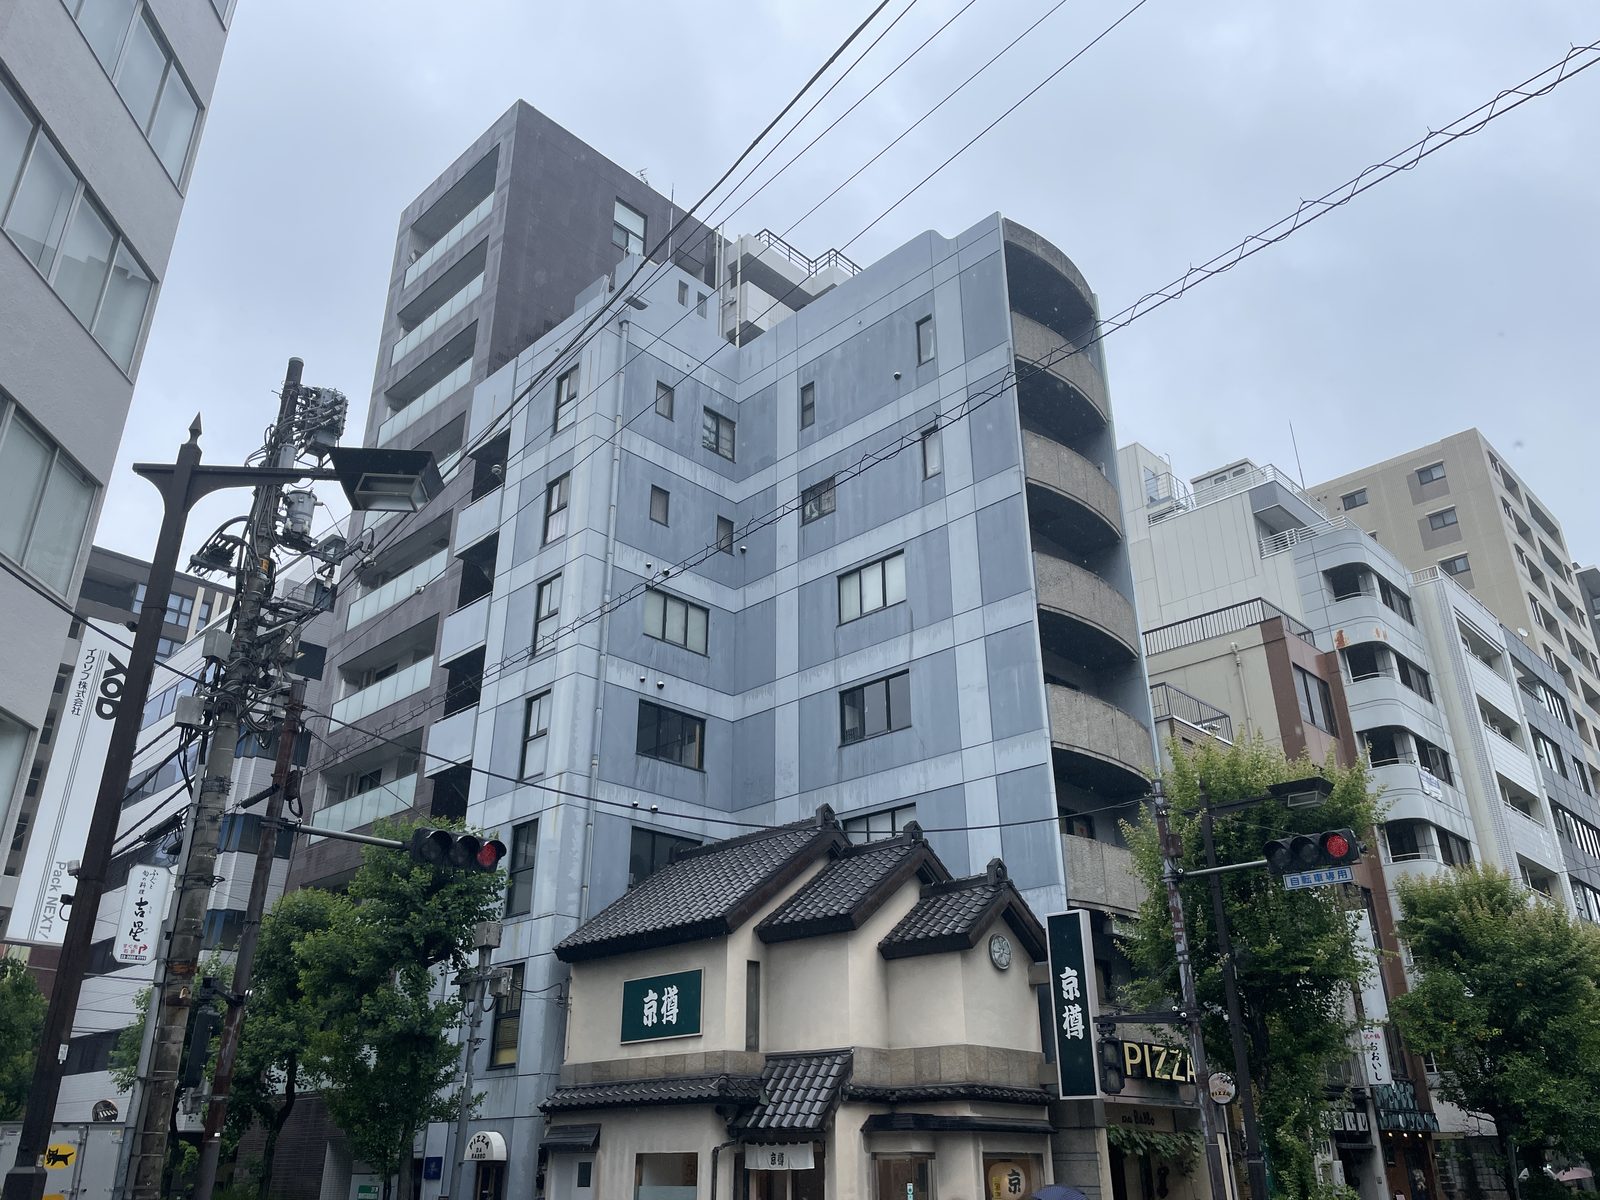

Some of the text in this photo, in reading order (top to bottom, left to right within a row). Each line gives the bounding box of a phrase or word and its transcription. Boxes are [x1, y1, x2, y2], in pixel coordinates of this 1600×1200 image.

[48, 861, 67, 892] Pack
[1290, 869, 1348, 887] 自転車専用
[643, 985, 679, 1027] 京樽
[1060, 966, 1085, 1040] 京樽
[1123, 1042, 1197, 1082] PIZZA
[469, 1135, 490, 1150] PIZZA
